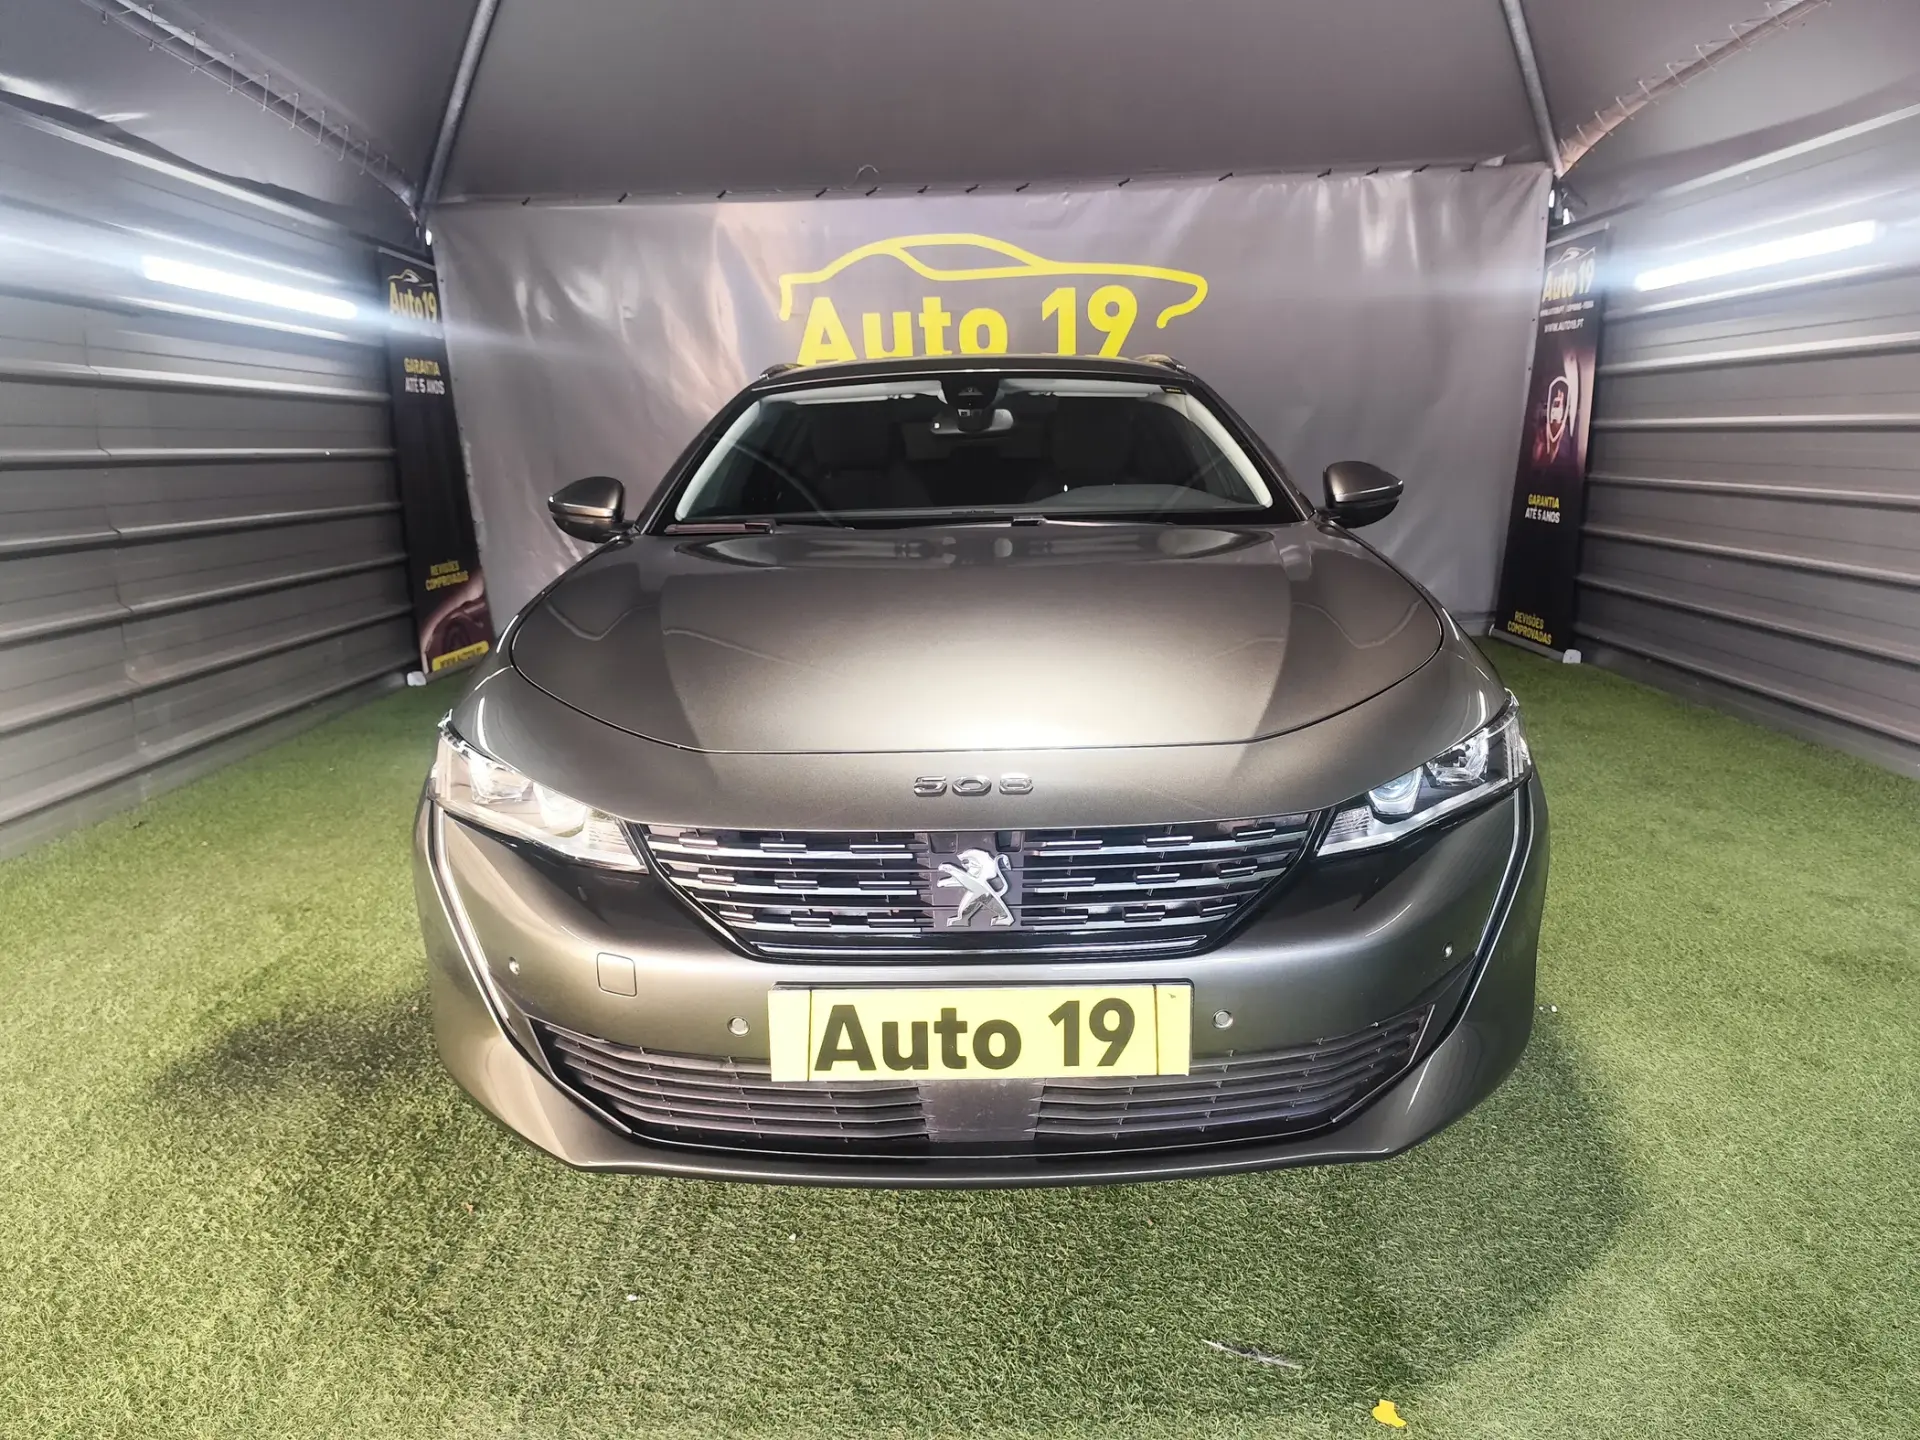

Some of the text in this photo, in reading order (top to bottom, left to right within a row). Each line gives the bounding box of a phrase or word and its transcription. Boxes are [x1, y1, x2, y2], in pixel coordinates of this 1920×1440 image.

[1542, 258, 1595, 302] Auto 19
[797, 285, 1138, 366] Auto 19
[404, 357, 441, 376] GARANTIA
[419, 378, 426, 394] 5
[426, 379, 446, 395] ANOS
[1528, 493, 1560, 509] GARANTIA
[1525, 506, 1561, 524] ATÉ 5 ANOS
[1507, 620, 1552, 645] COMPROVADAS
[914, 772, 1034, 797] 508
[814, 997, 1136, 1071] Auto 19
